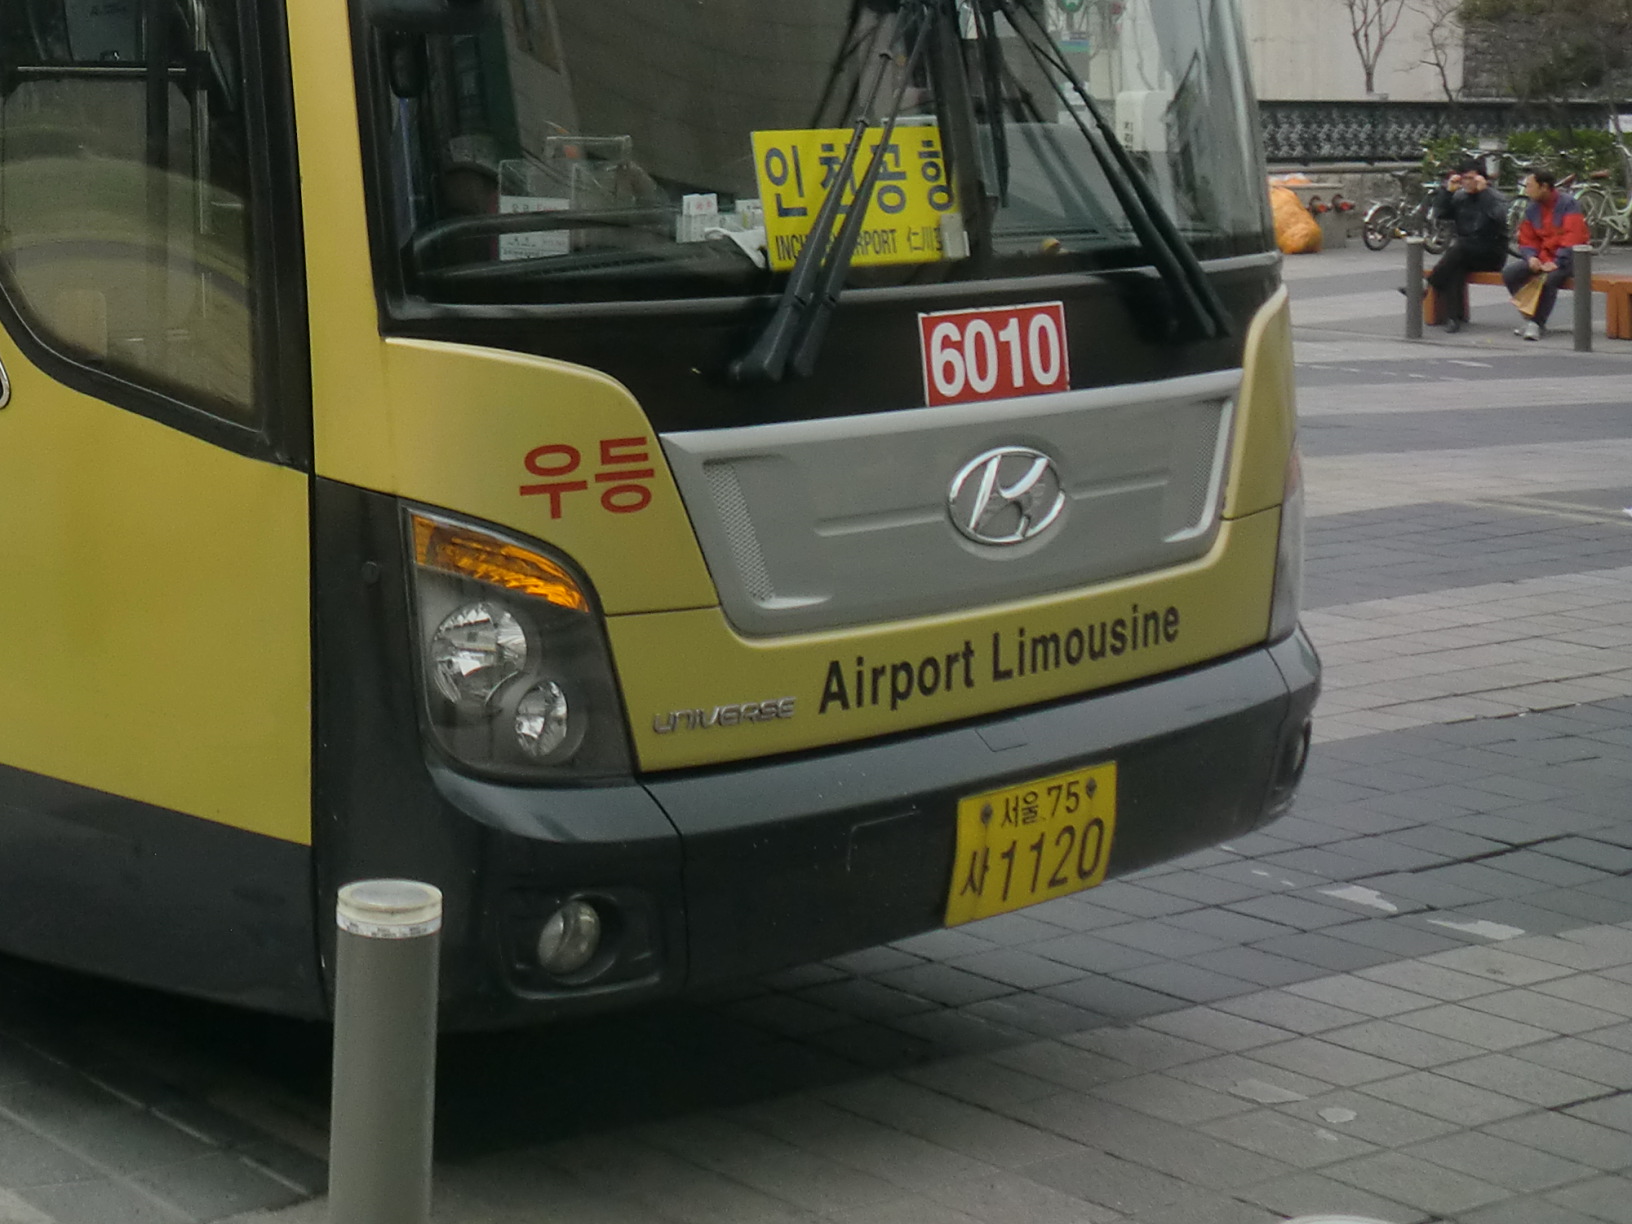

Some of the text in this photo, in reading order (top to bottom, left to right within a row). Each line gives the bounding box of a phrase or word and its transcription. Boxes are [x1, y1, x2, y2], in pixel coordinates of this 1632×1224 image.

[931, 313, 1061, 398] 6010
[520, 435, 656, 519] 우등
[818, 603, 1180, 716] Airport Limousine
[653, 696, 797, 735] UNIVERSE
[999, 779, 1080, 829] 서울 75
[999, 817, 1105, 903] 1120
